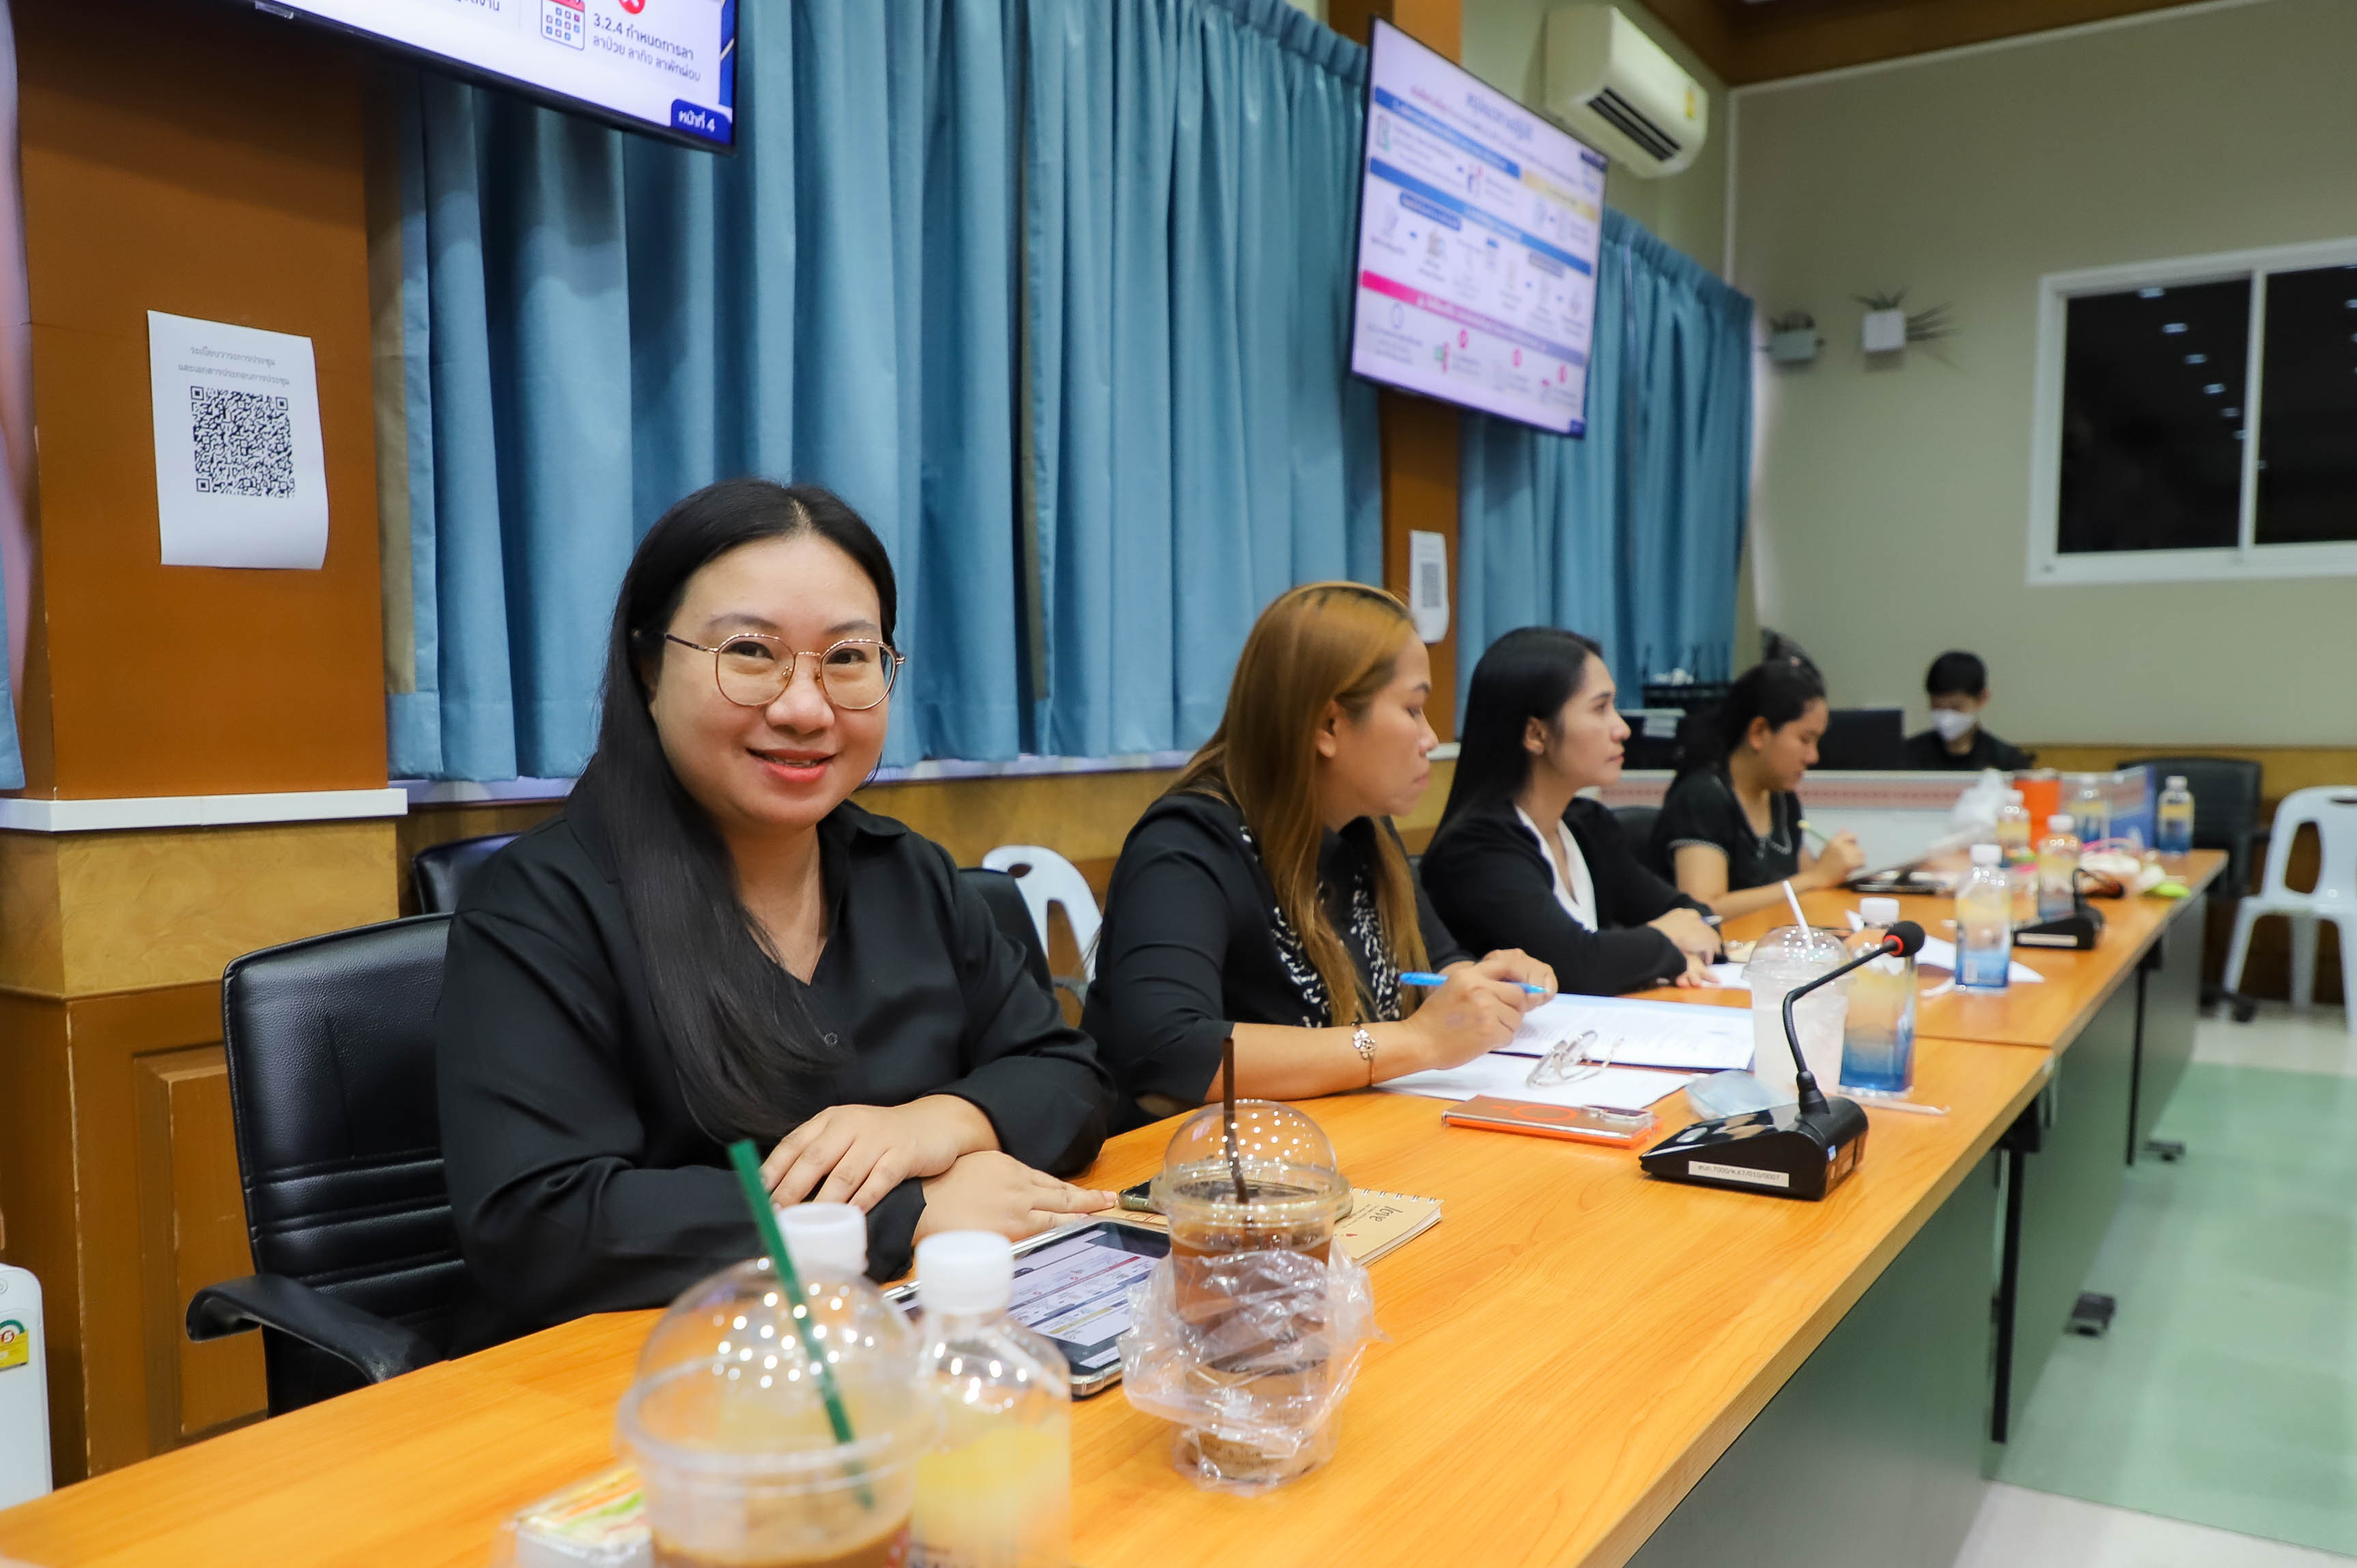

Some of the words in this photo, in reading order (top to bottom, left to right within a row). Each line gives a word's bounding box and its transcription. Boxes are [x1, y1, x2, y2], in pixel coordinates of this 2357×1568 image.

[593, 13, 623, 34] 3.2.4
[626, 24, 694, 60] กำหนดการลา
[678, 109, 705, 130] หน้าที่
[707, 117, 716, 132] 4
